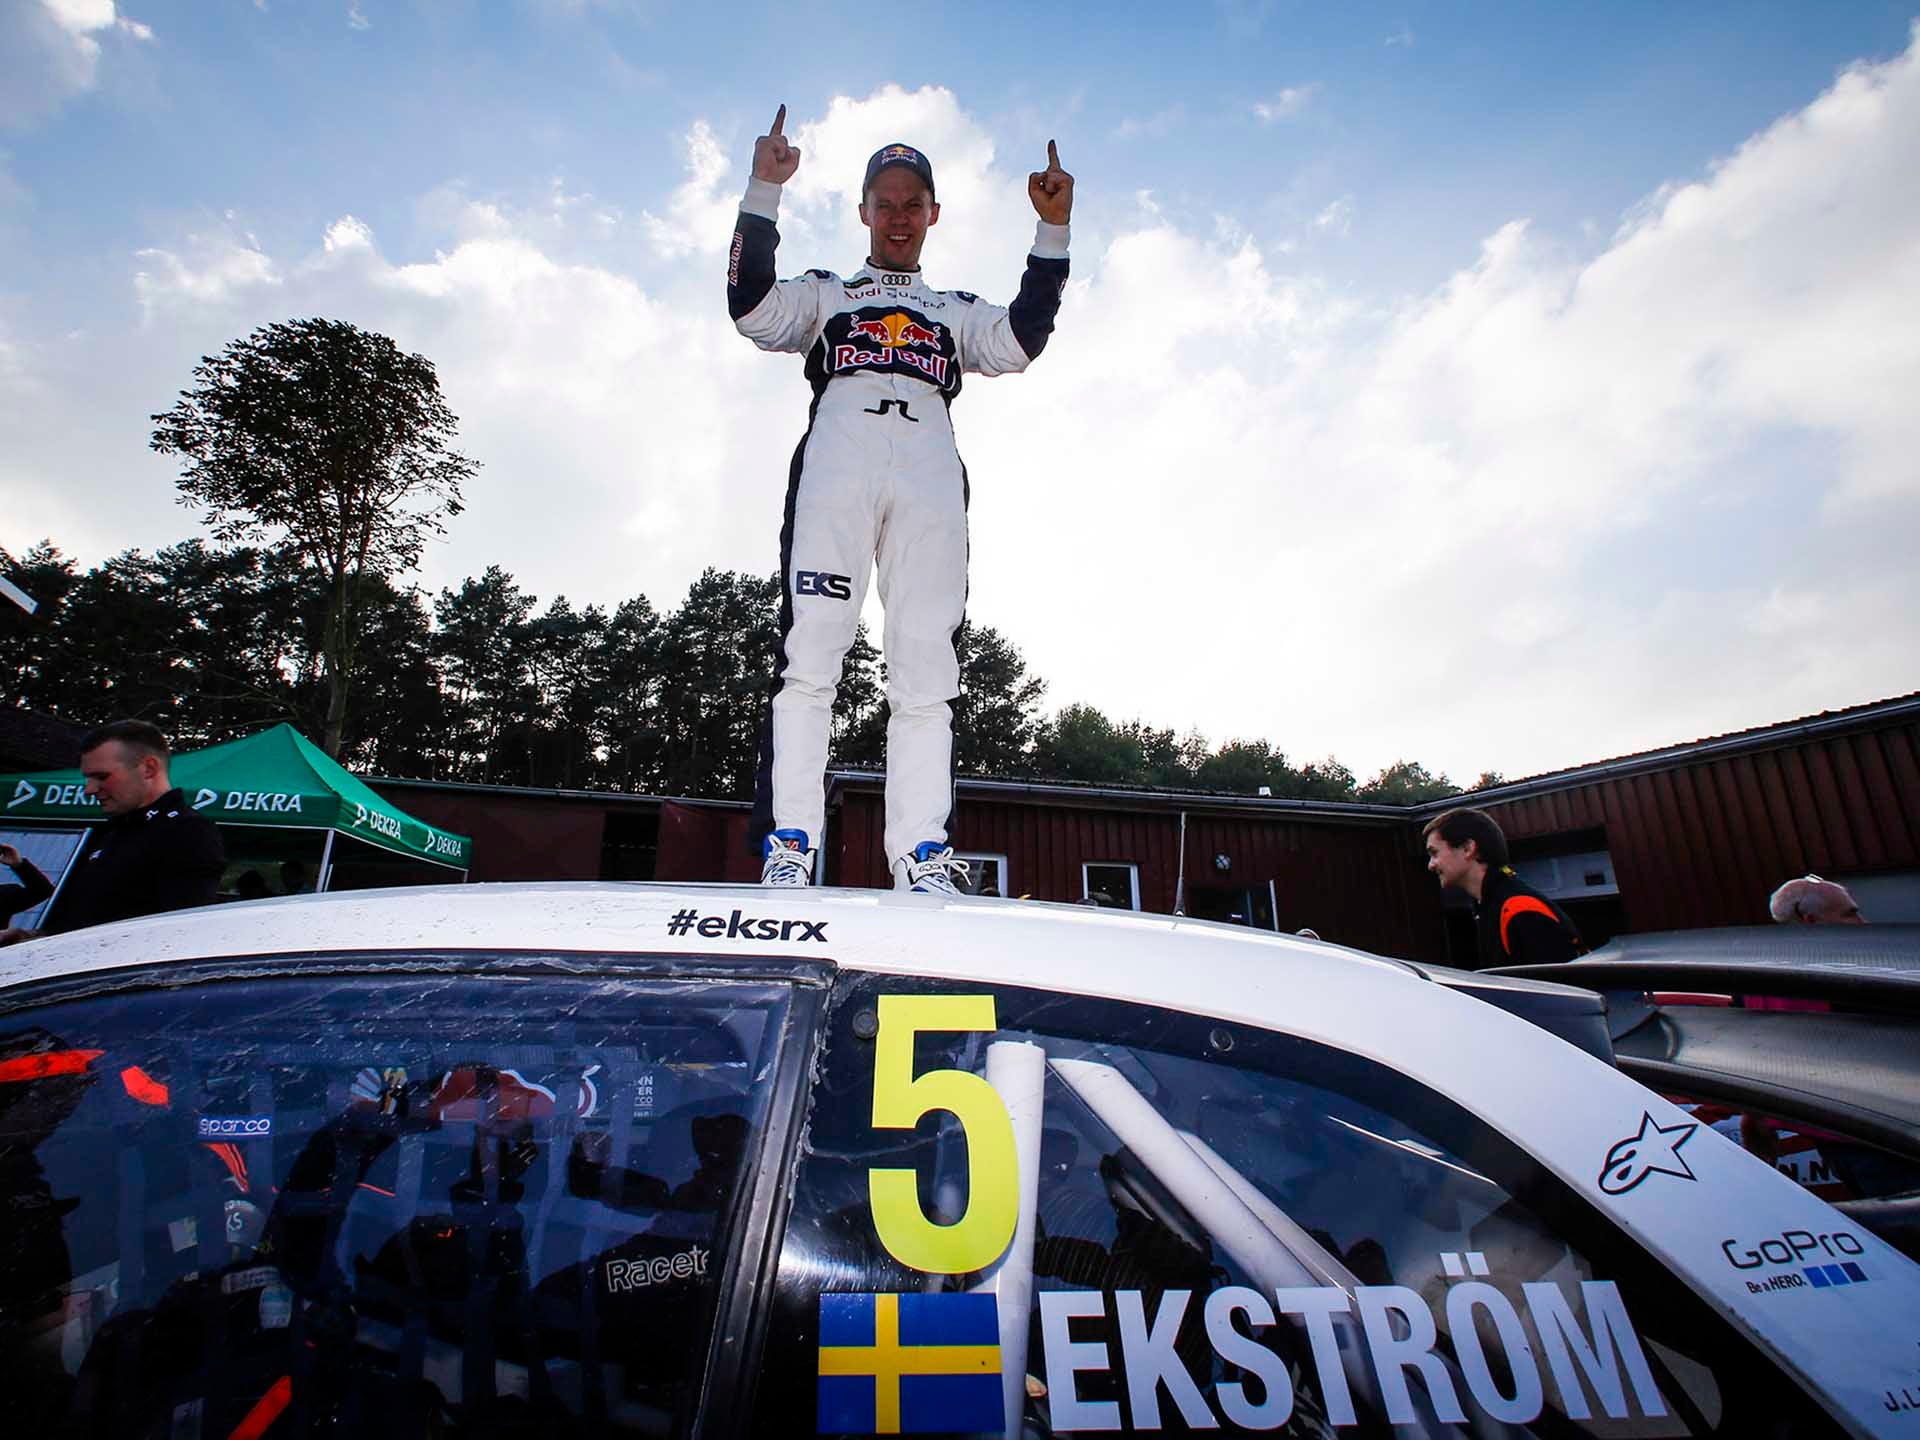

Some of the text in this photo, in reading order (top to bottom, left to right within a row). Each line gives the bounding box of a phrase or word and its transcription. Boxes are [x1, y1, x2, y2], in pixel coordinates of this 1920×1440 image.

[834, 344, 948, 385] Red Bull
[796, 570, 852, 601] EKS
[223, 791, 303, 812] DEKRA
[369, 810, 401, 840] DEKRA
[436, 836, 462, 857] DEKRA
[667, 908, 829, 942] #eksrx
[200, 1118, 271, 1137] sparco
[869, 995, 1020, 1274] 5
[1722, 1231, 1864, 1270] GoPro
[1745, 1281, 1763, 1294] Be
[1768, 1273, 1808, 1290] HERO.
[1038, 1252, 1669, 1432] EKSTRÖM
[1883, 1387, 1920, 1411] J.L
